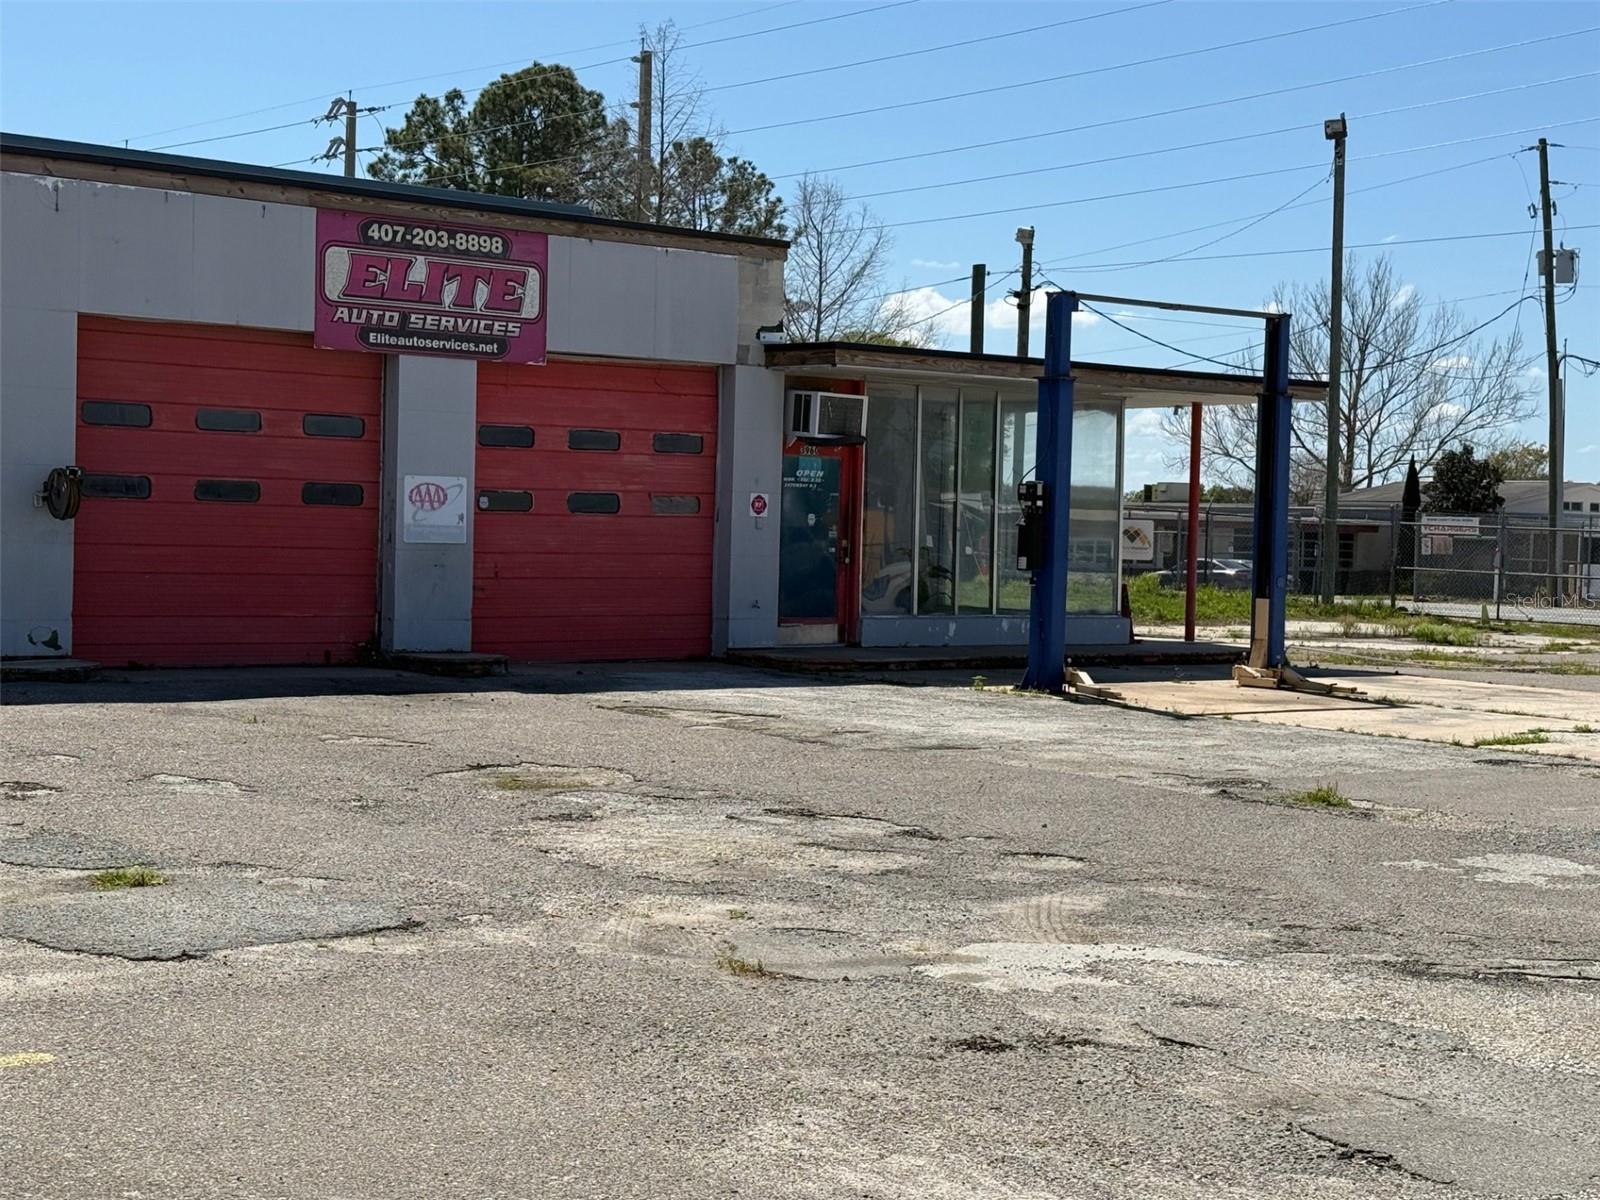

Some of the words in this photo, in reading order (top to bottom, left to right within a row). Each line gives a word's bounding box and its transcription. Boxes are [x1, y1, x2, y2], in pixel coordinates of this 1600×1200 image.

[368, 223, 504, 254] 407-203-8898
[339, 251, 528, 315] ELITE
[333, 306, 400, 327] AUTO
[409, 313, 521, 337] SERVICES
[369, 333, 498, 353] Eliteautoservices.net
[414, 484, 443, 510] AAA
